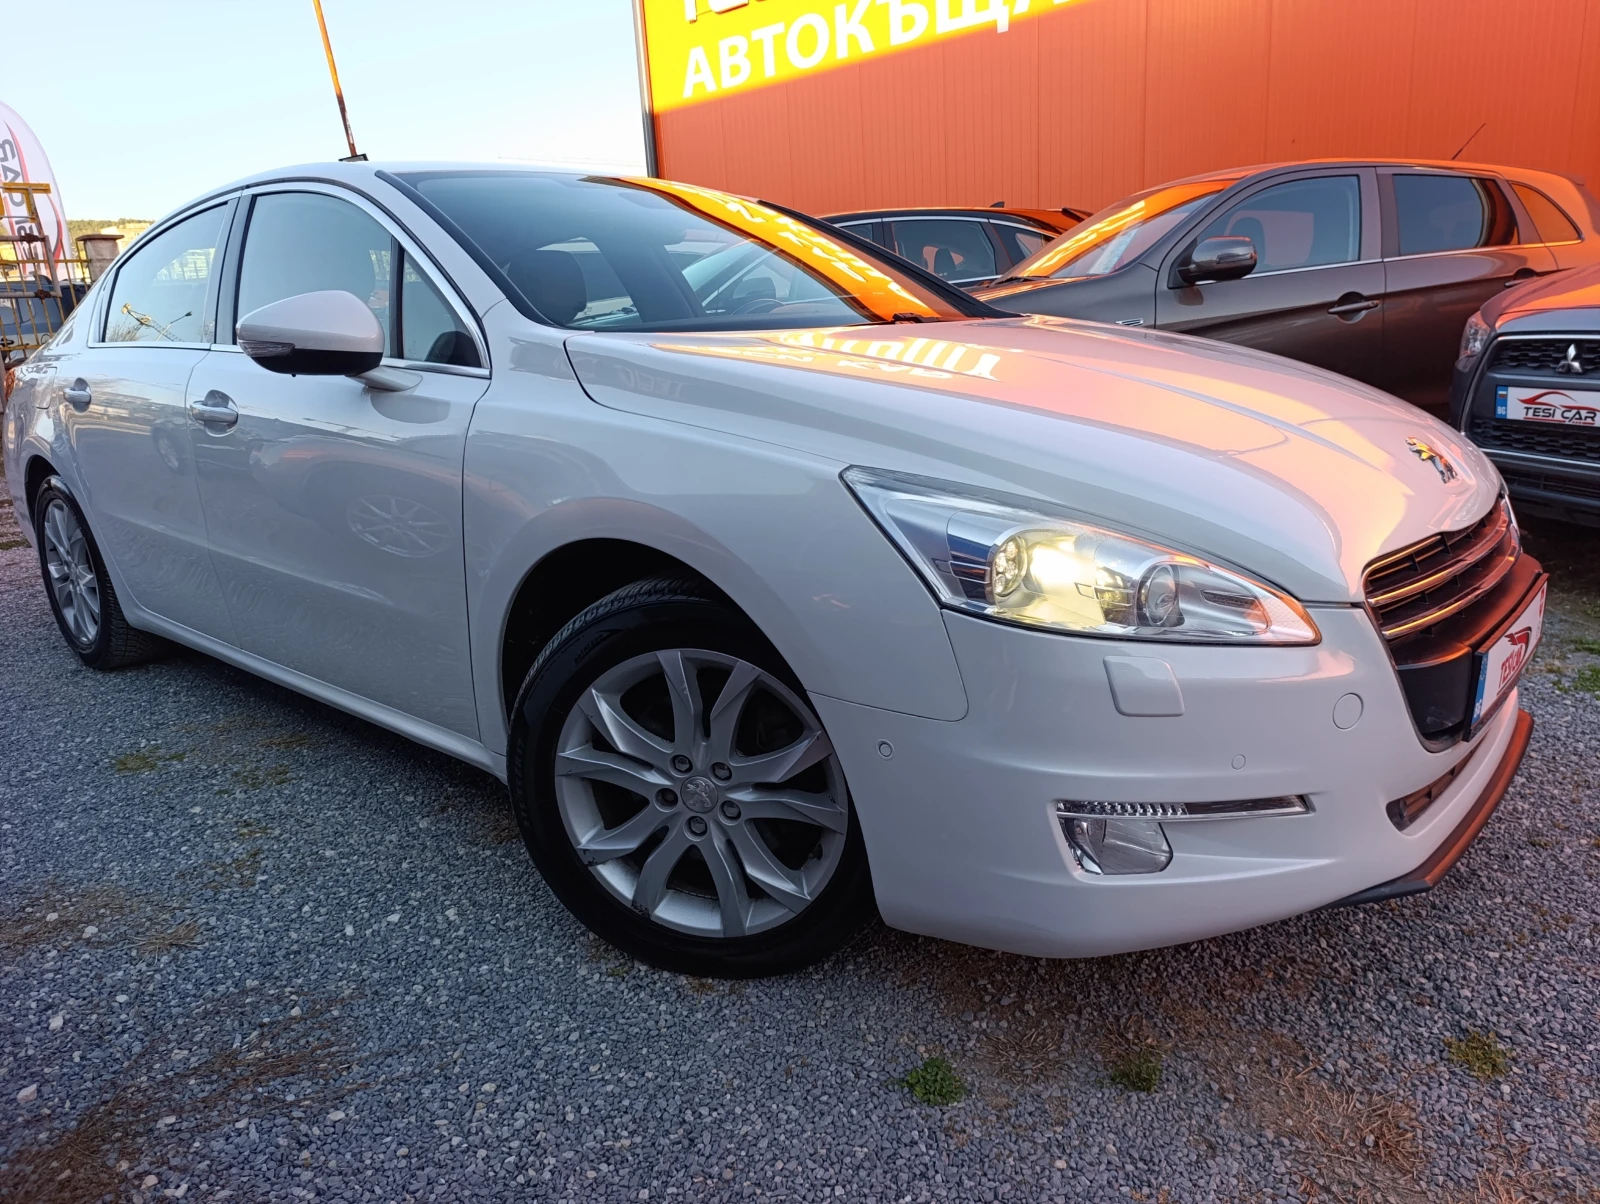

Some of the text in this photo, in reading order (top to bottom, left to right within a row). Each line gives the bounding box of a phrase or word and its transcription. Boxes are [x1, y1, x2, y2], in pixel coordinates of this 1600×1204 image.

[683, 0, 1072, 98] АВТОКЪЩ
[1497, 405, 1506, 415] BG
[1524, 406, 1597, 423] TESI CAR
